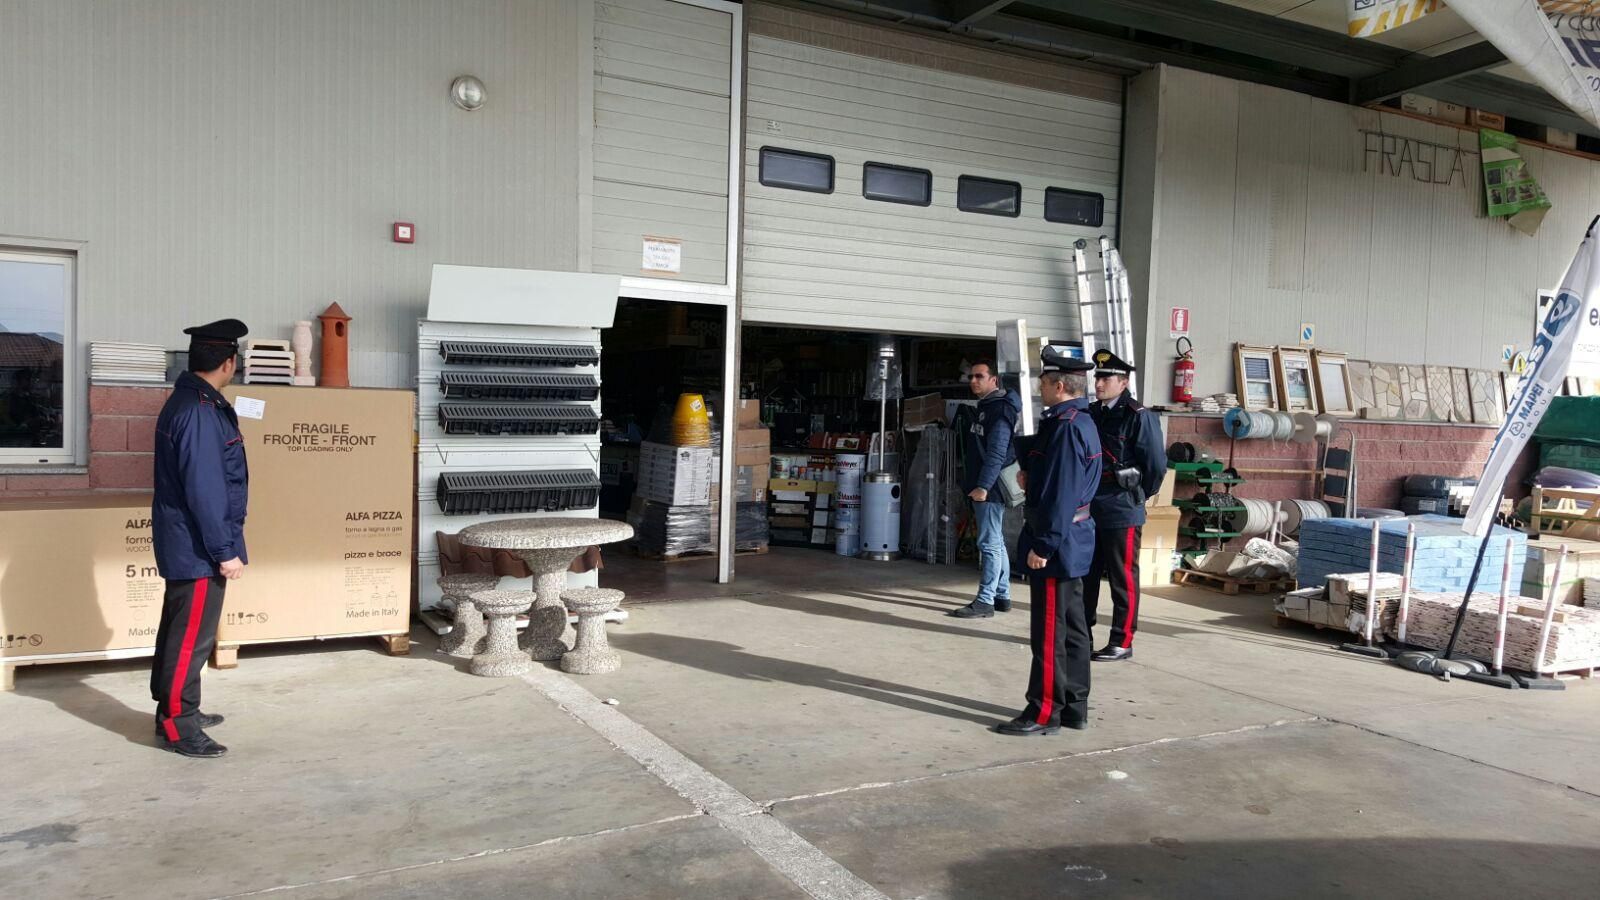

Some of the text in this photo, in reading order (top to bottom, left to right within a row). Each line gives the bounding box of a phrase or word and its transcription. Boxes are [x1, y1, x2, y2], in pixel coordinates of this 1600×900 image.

[1518, 383, 1545, 420] MAPEI
[292, 423, 350, 434] FRAGILE
[263, 434, 319, 445] FRONTE
[332, 435, 377, 446] FRONT
[345, 511, 403, 521] ALFA PIZZA
[125, 519, 152, 529] ALFA
[344, 550, 367, 561] pizza
[376, 549, 402, 558] brace
[125, 564, 137, 578] 5
[346, 607, 399, 618] Made in Italy
[128, 626, 157, 637] Made
